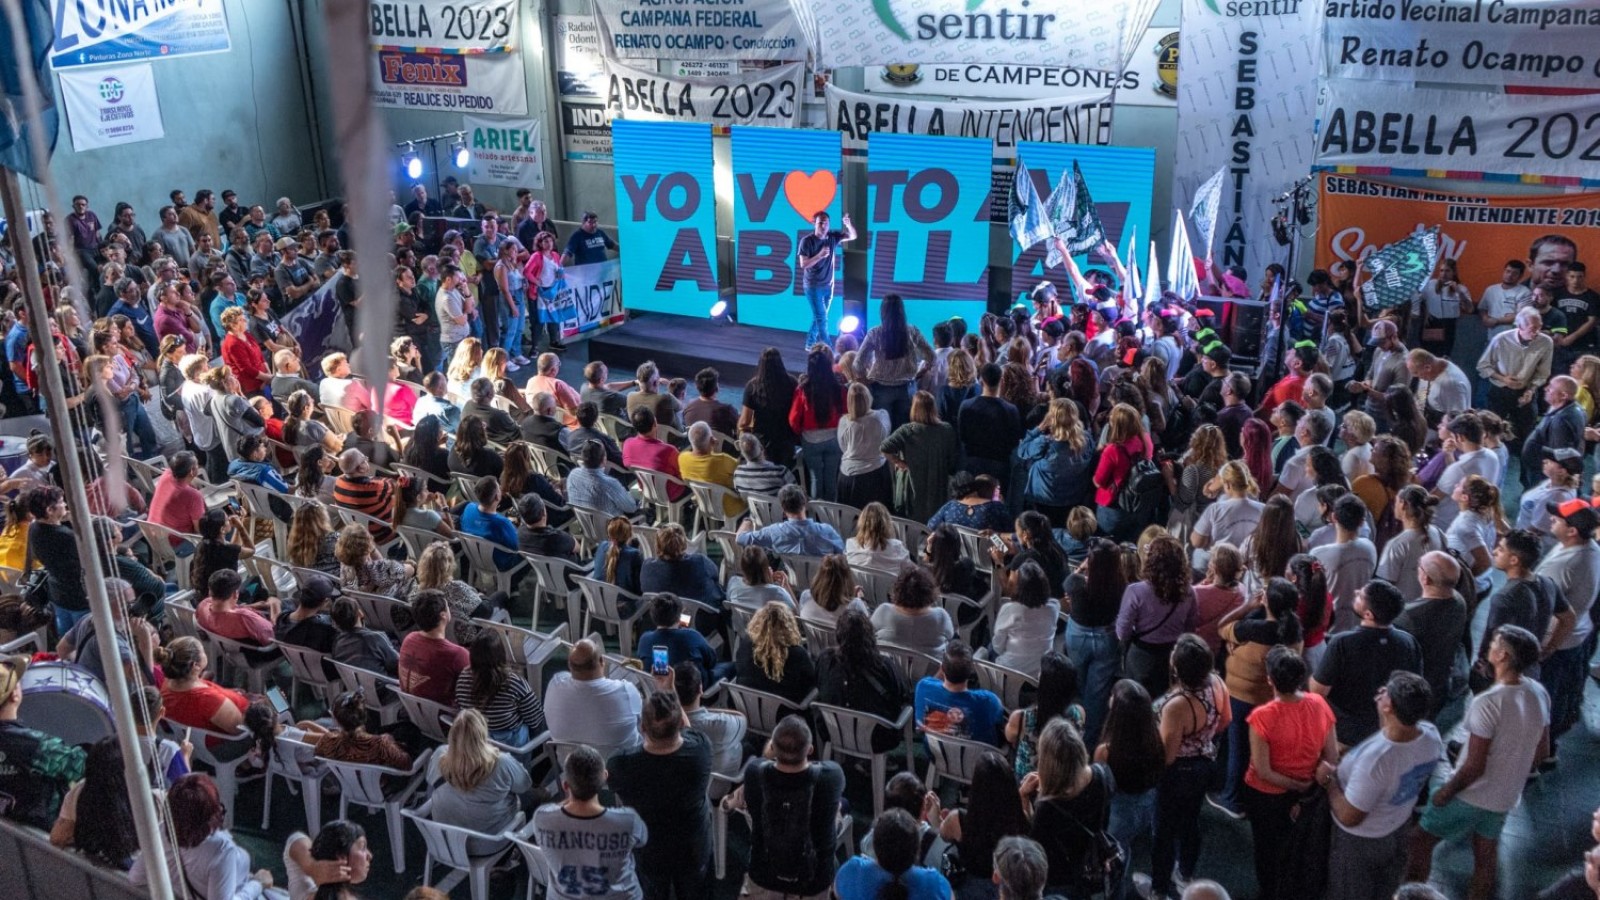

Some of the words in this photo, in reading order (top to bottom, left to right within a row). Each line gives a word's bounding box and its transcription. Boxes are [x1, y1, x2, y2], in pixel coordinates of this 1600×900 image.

[441, 6, 510, 40] 2023
[620, 10, 692, 27] CAMPANA
[695, 10, 763, 28] FEDERAL
[916, 0, 1056, 41] sentir
[1400, 0, 1480, 22] Vecinal
[1487, 0, 1600, 30] Campana
[614, 33, 661, 48] RENATO
[665, 34, 724, 49] OCAMPO
[732, 35, 795, 49] Conducción
[383, 54, 462, 84] Fenix
[1340, 36, 1449, 68] Renato
[1462, 40, 1584, 78] Ocampo
[935, 68, 960, 82] DE
[964, 64, 1140, 90] CAMPEONES
[404, 92, 442, 106] REALICE
[443, 95, 457, 107] SU
[458, 95, 494, 109] PEDIDO
[607, 73, 697, 119] ABELLA
[710, 79, 796, 119] 2023
[837, 99, 945, 140] ABELLA
[960, 102, 1112, 147] INTENDENTE
[1321, 107, 1478, 156] ABELLA
[473, 127, 535, 152] ARIEL
[1223, 31, 1259, 267] SEBASTIÁN
[474, 151, 498, 161] helado
[501, 154, 536, 163] artesanal
[620, 171, 701, 222] YO
[1326, 176, 1419, 199] SEBASTIAN
[1448, 205, 1558, 225] INTENDENTE
[1561, 208, 1600, 227] 201
[538, 828, 631, 851] TRANCOSO
[558, 865, 610, 896] 45
